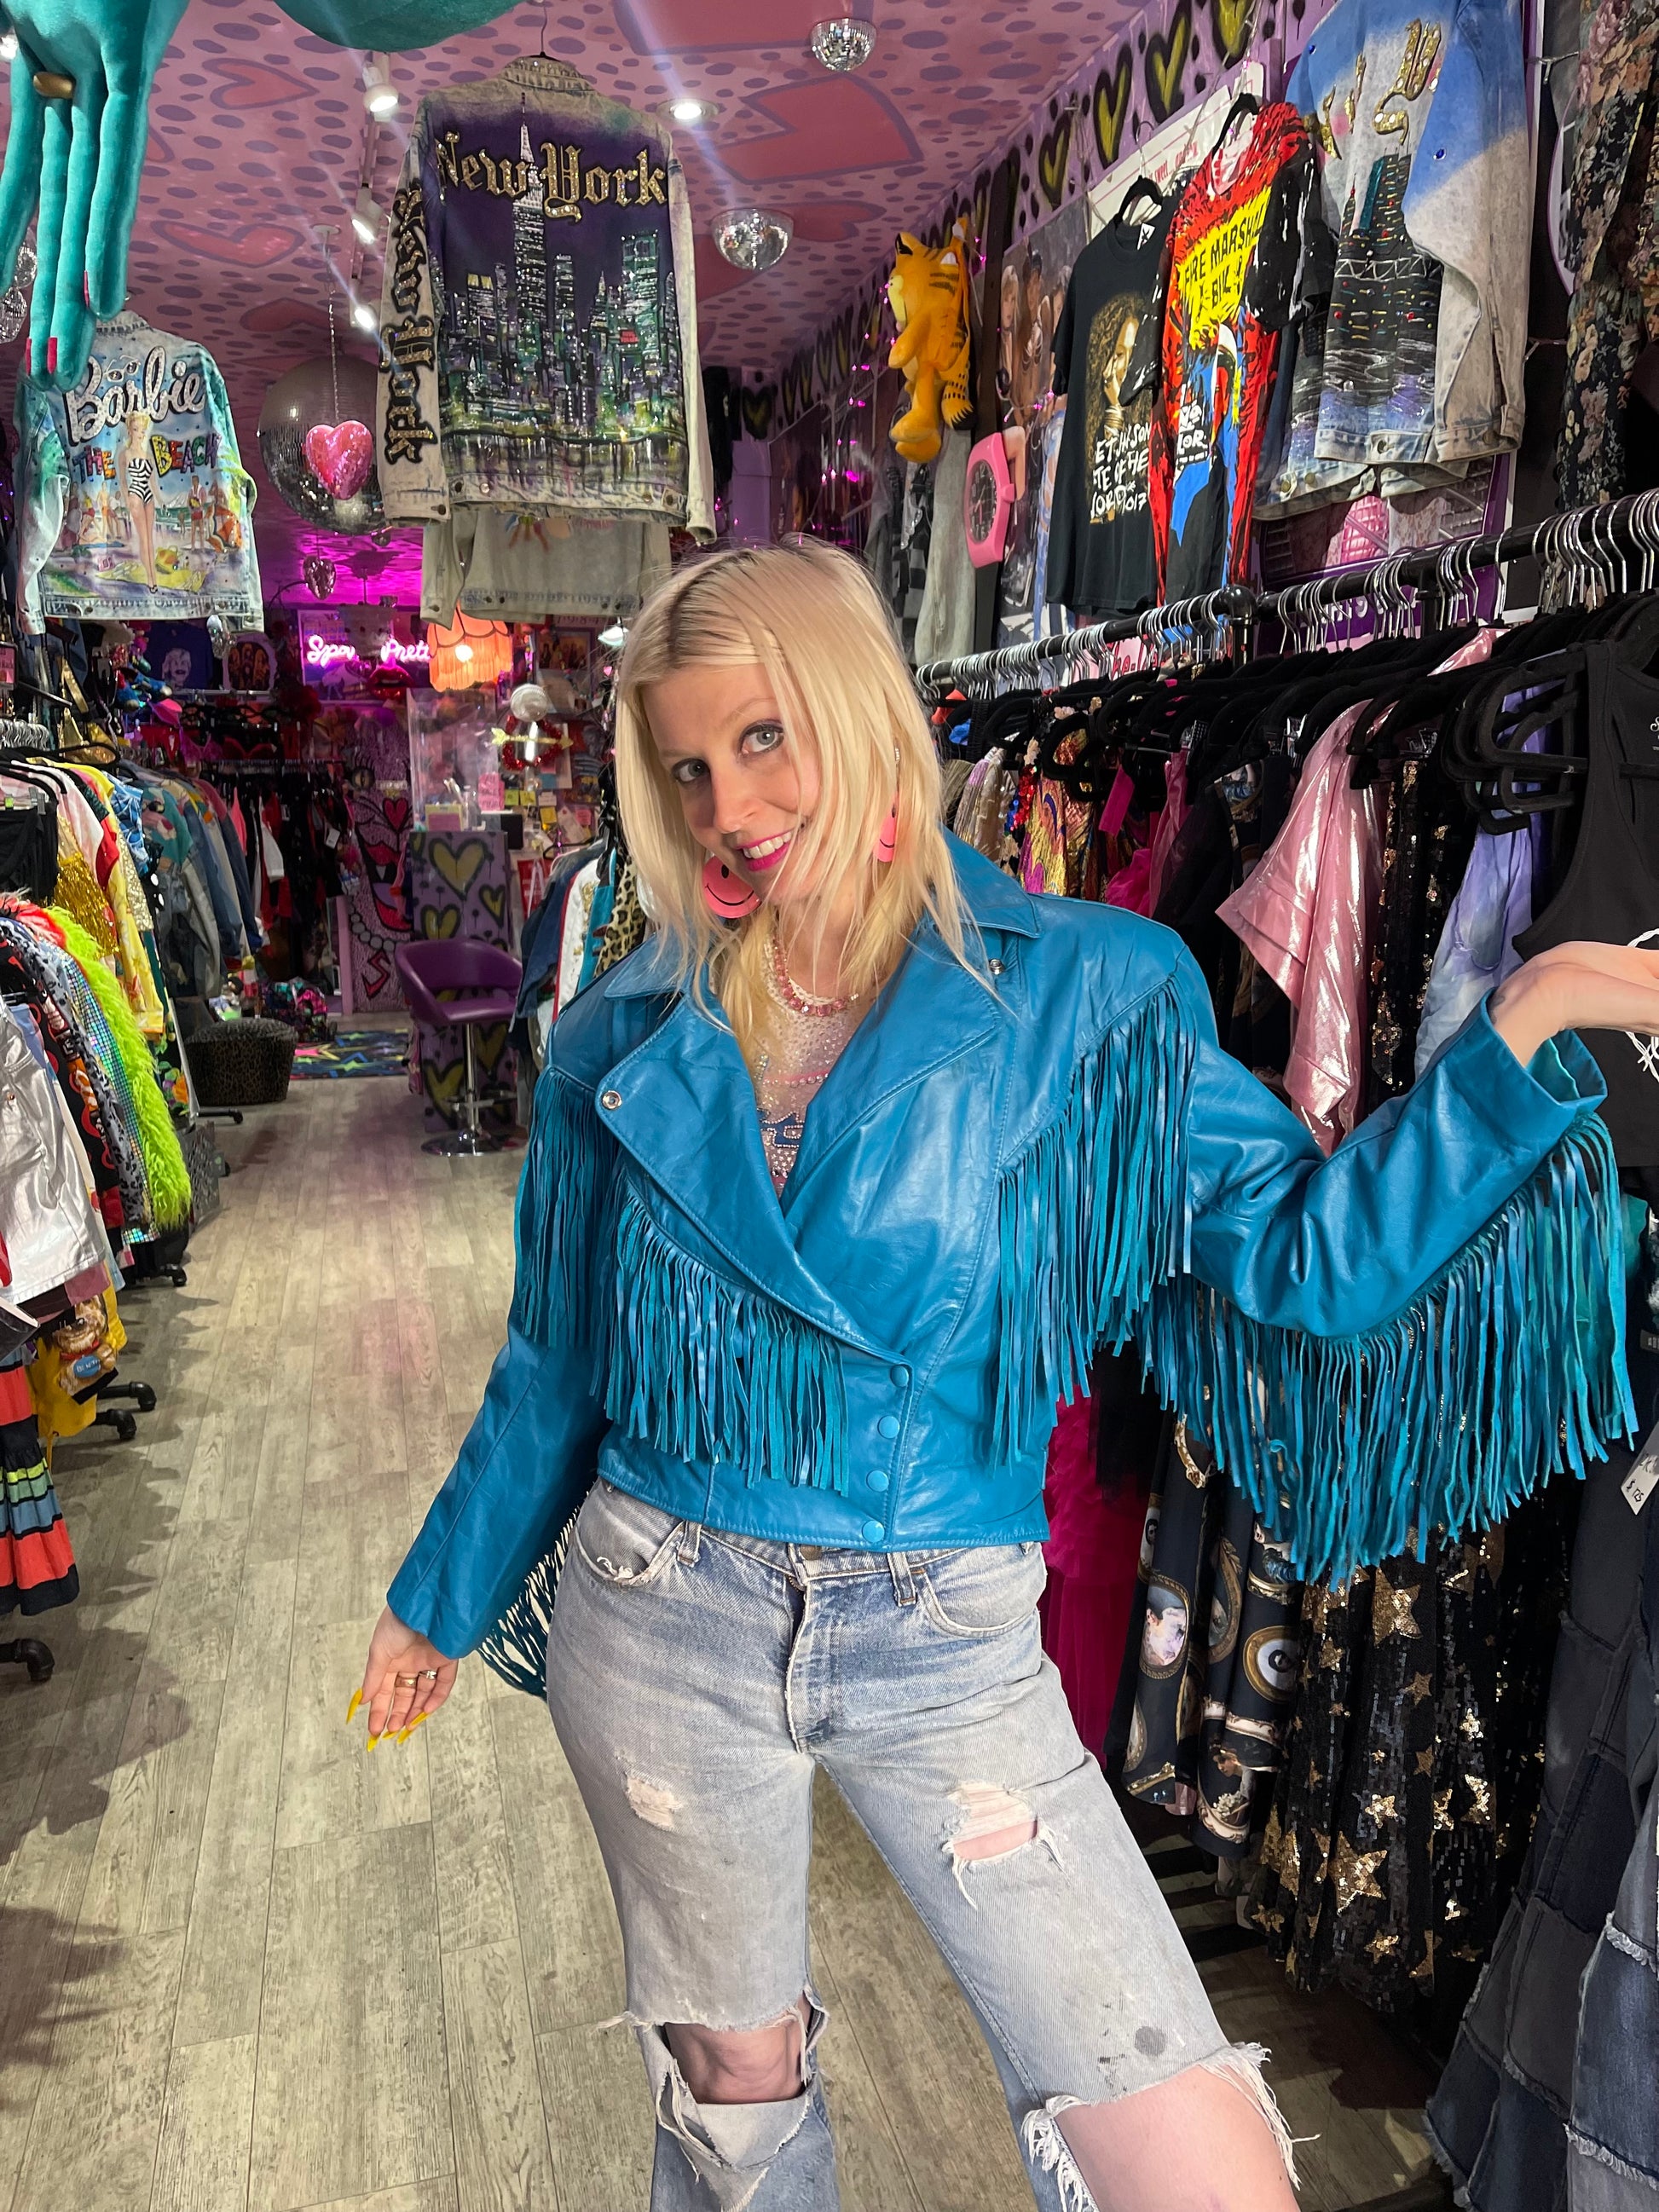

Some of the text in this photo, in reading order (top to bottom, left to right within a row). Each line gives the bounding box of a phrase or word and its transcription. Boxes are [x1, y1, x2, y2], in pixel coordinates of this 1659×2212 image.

[434, 130, 668, 223] New York
[380, 181, 435, 463] New York
[63, 345, 207, 446] Barbie
[72, 432, 223, 484] THE BEACH
[1126, 448, 1149, 476] THE
[380, 638, 431, 662] Prett
